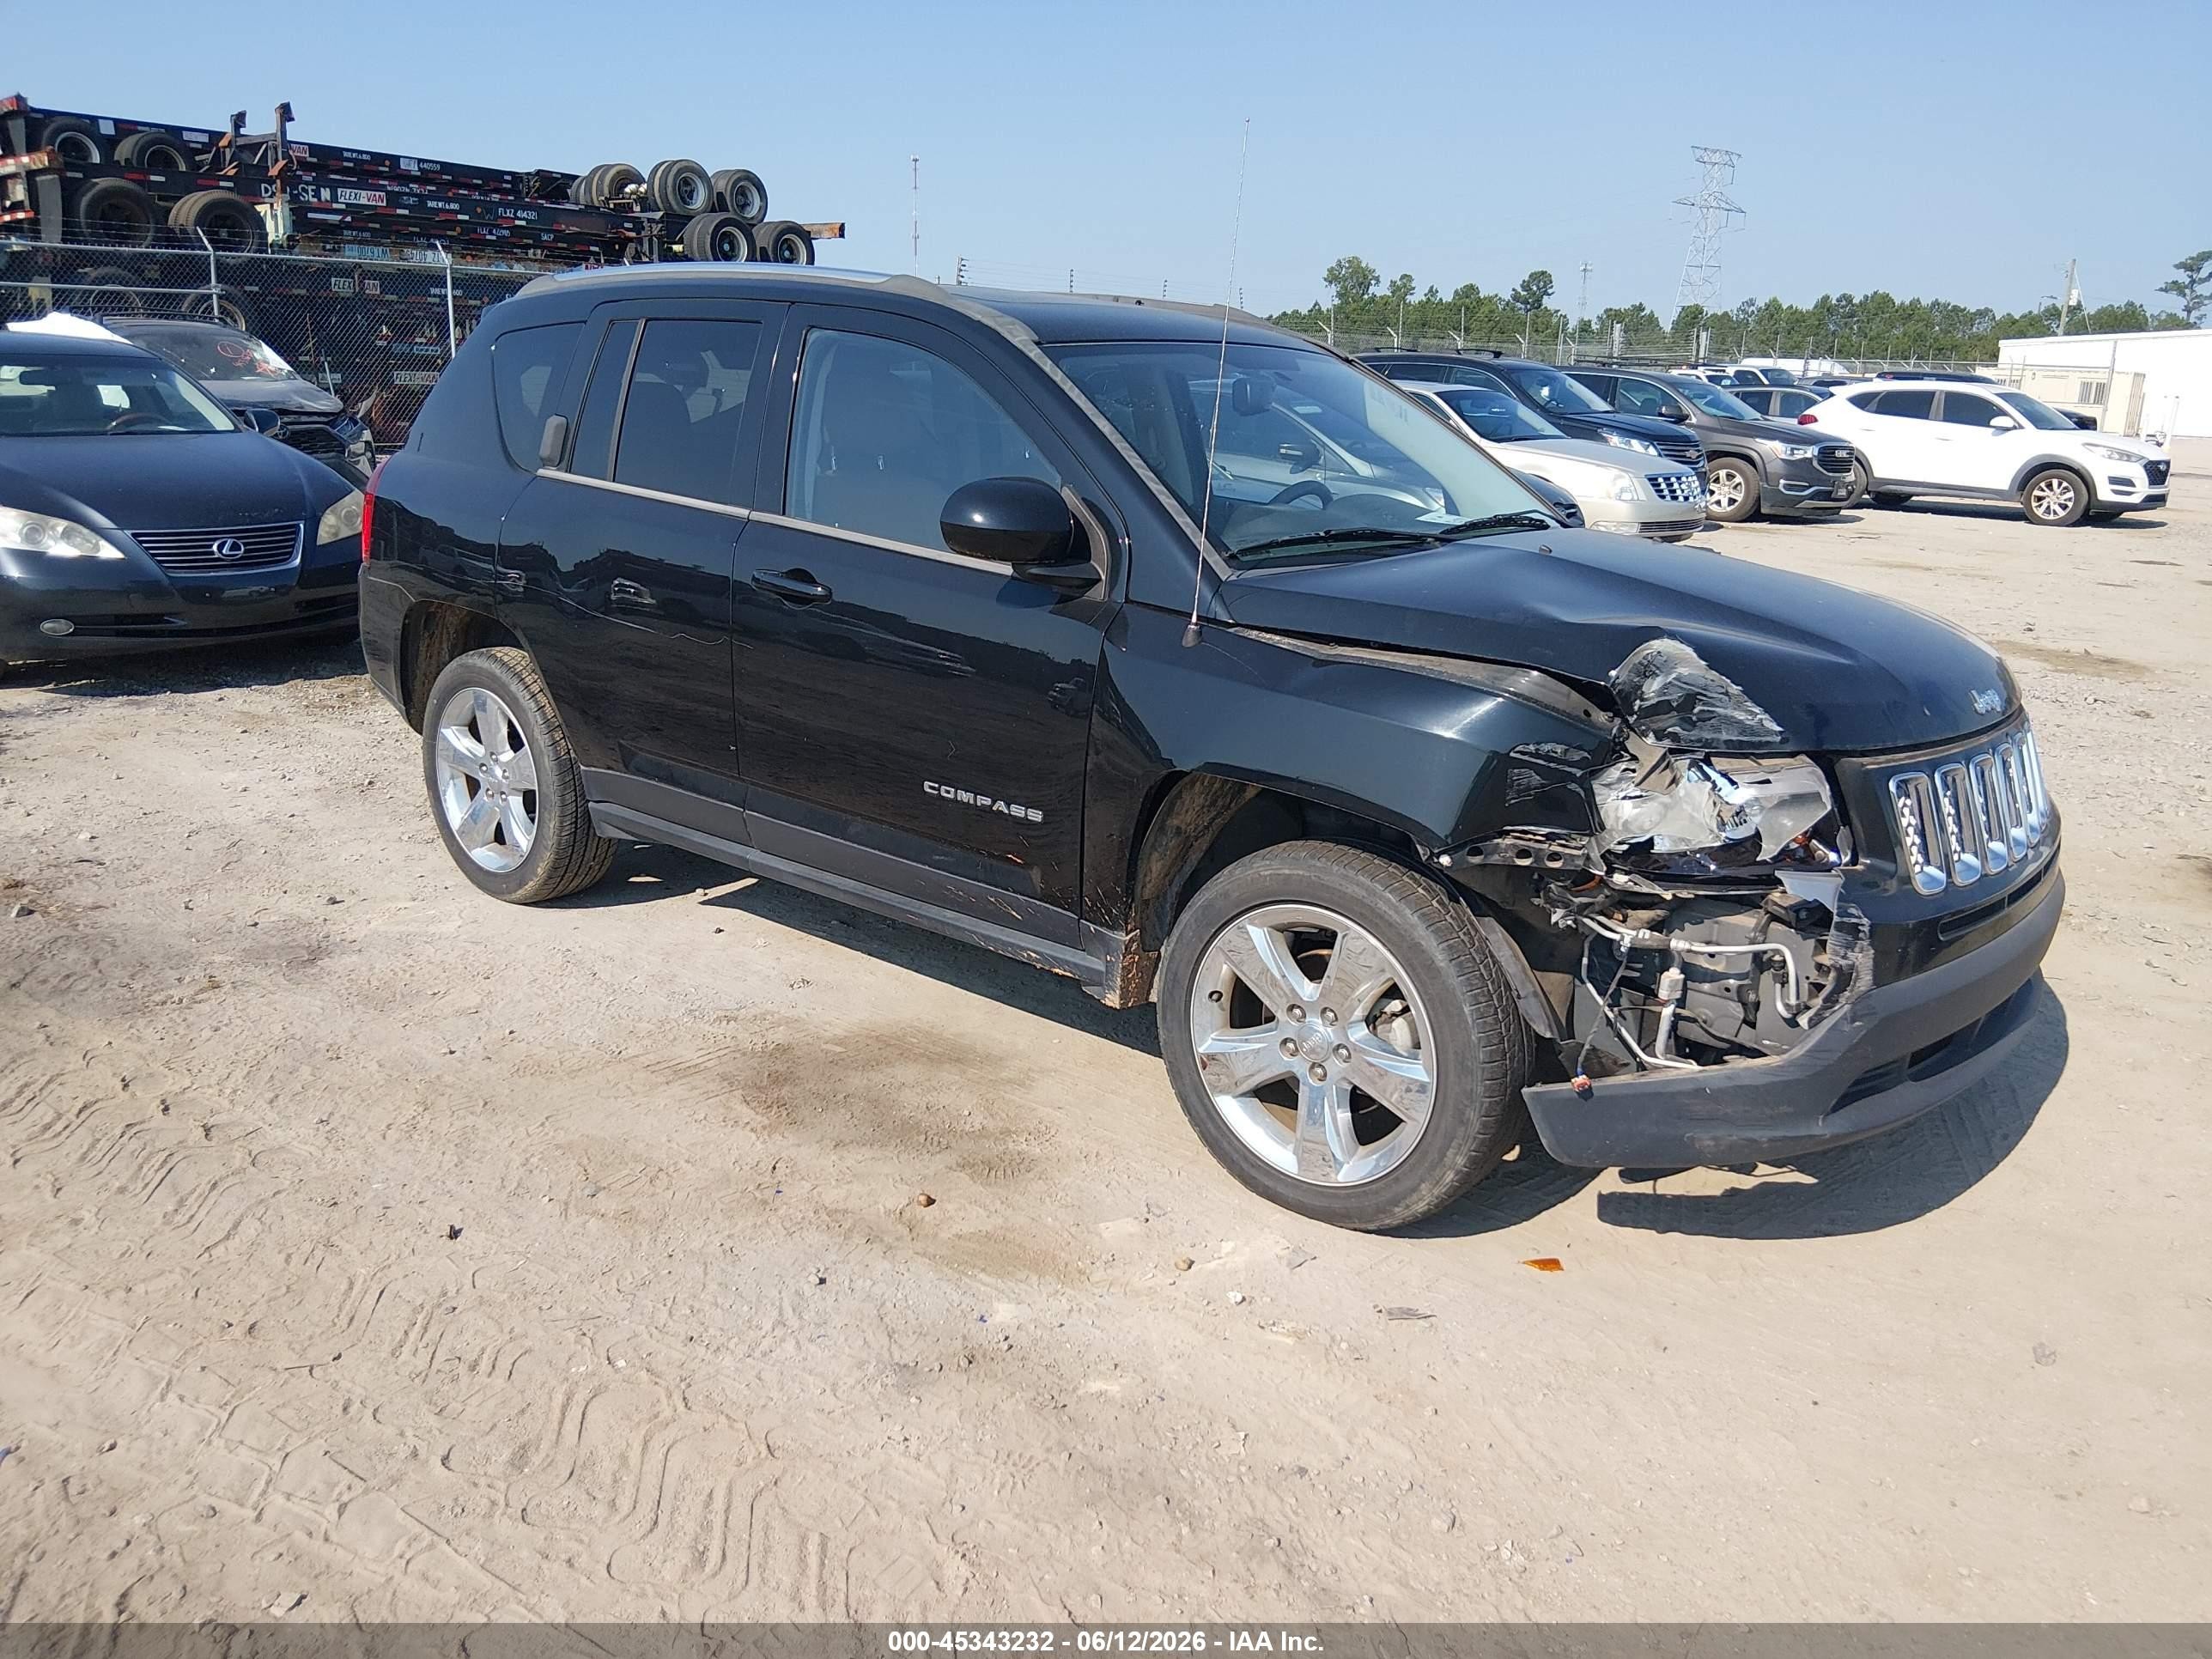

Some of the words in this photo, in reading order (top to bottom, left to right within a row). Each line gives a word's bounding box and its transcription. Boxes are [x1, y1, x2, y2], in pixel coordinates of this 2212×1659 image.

[339, 190, 386, 204] FLEXI-VAN
[498, 208, 514, 218] FLXZ
[516, 209, 538, 221] 414321
[1968, 688, 2002, 714] Jeep
[923, 781, 1043, 823] COMPASS
